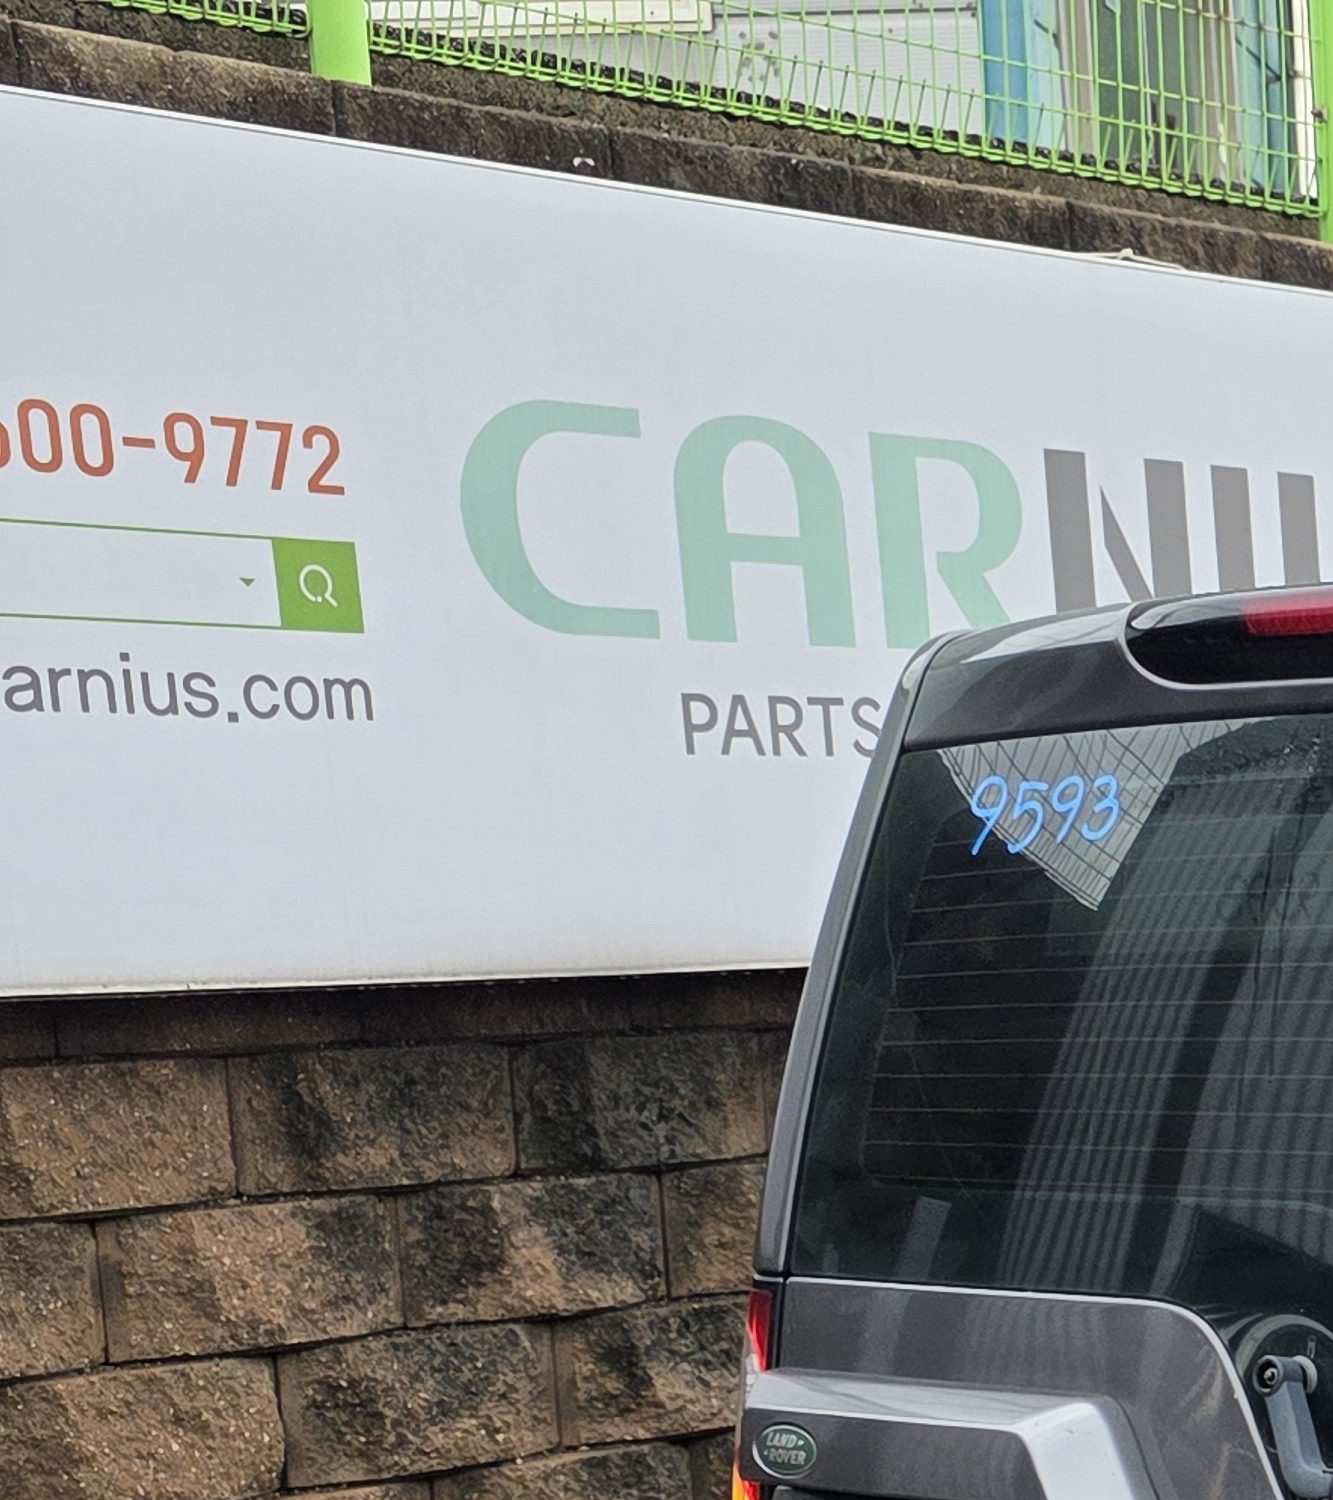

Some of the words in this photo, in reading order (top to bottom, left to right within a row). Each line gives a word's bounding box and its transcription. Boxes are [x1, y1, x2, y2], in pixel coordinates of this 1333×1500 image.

[0, 399, 346, 496] 00-9772
[1, 652, 374, 723] arnius.com
[680, 692, 881, 759] PARTS
[969, 774, 1121, 857] 9593
[766, 1431, 798, 1449] LAND
[768, 1448, 807, 1465] ROVER
